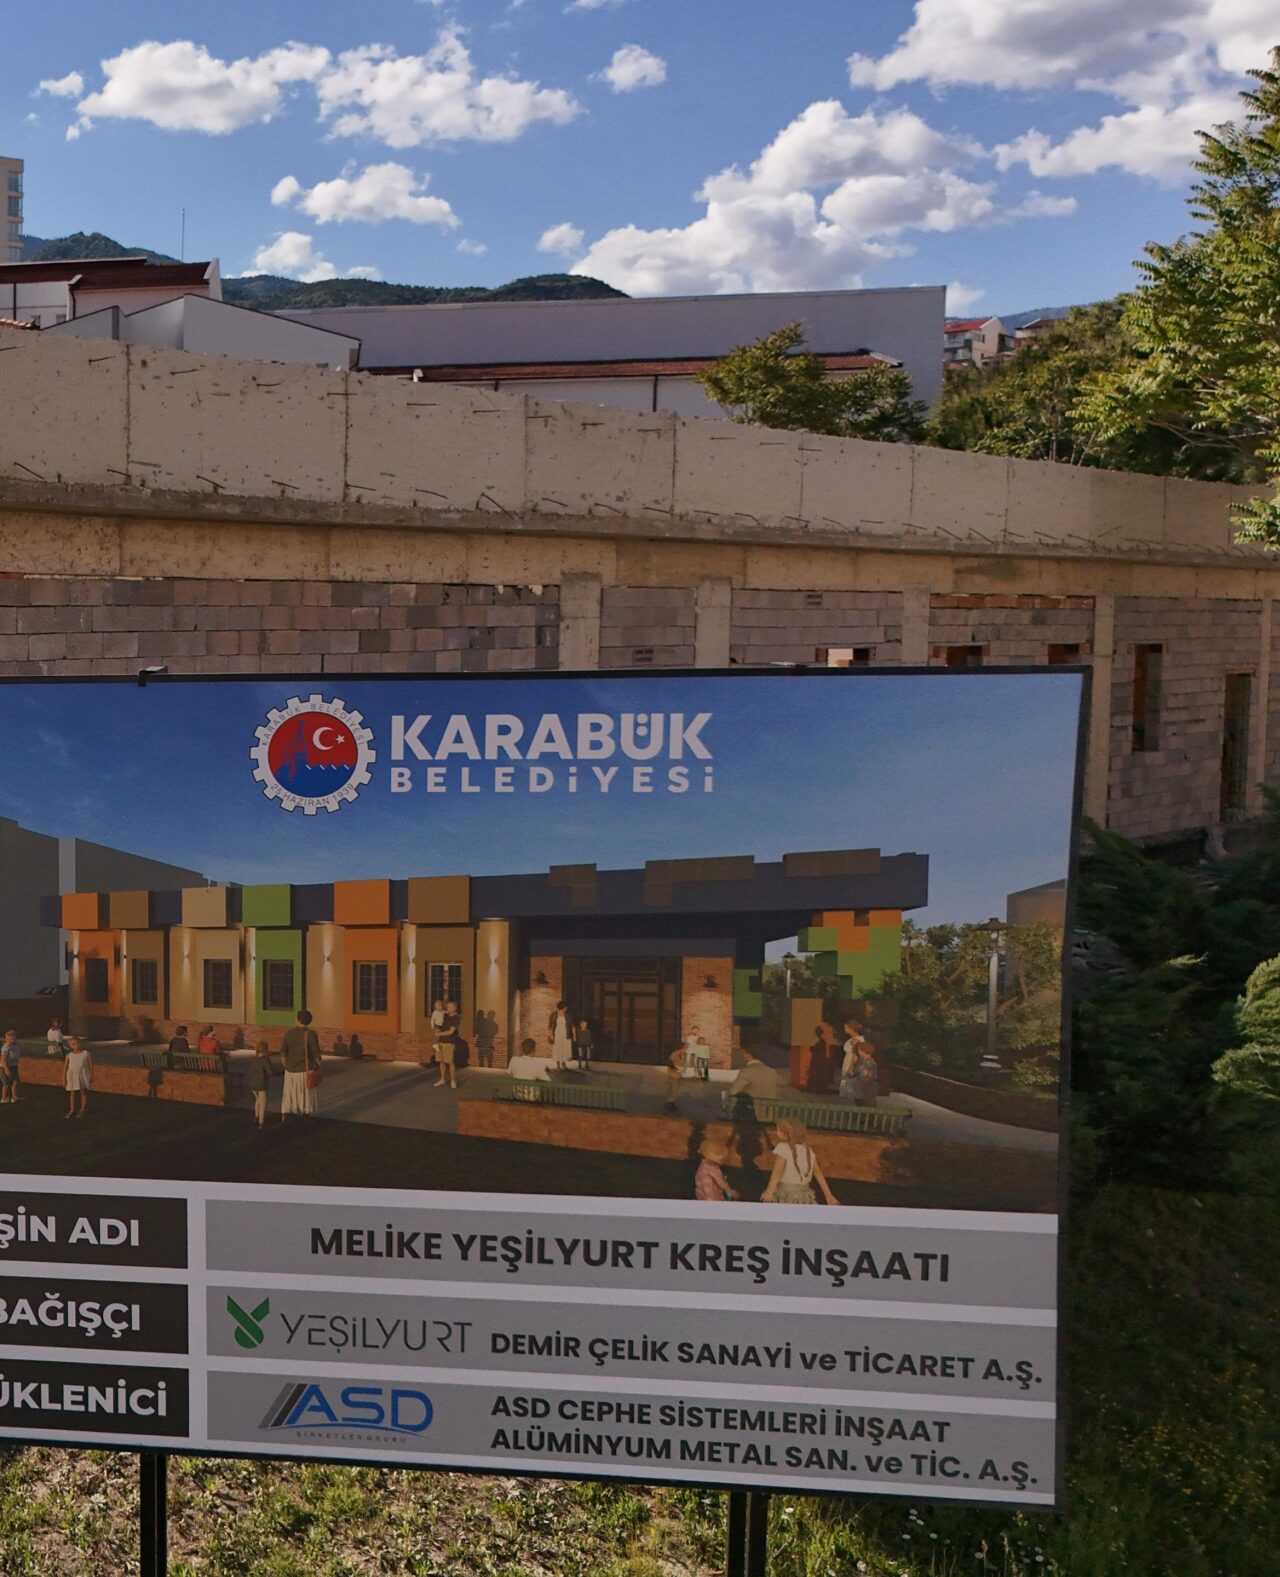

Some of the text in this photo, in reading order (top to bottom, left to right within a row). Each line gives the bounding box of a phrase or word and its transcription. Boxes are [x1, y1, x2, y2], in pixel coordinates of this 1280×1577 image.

[390, 712, 713, 761] KARABÜK
[270, 783, 281, 796] 25
[333, 783, 355, 801] 1939
[390, 765, 714, 794] BELEDİYESİ
[68, 1217, 140, 1247] ADI
[310, 1223, 950, 1287] MELİKE YEŞİLYURT KREŞ İNŞAATI
[491, 1330, 1042, 1390] DEMİR ÇELİK SANAYİ ve TİCARET A.Ş.
[282, 1383, 434, 1433] ASD
[490, 1395, 951, 1446] ASD CEPHE SİSTEMLERİ İNŞAAT
[490, 1425, 1038, 1490] ALÜMİNYUM METAL SAN. ve TİC. A.Ş.
